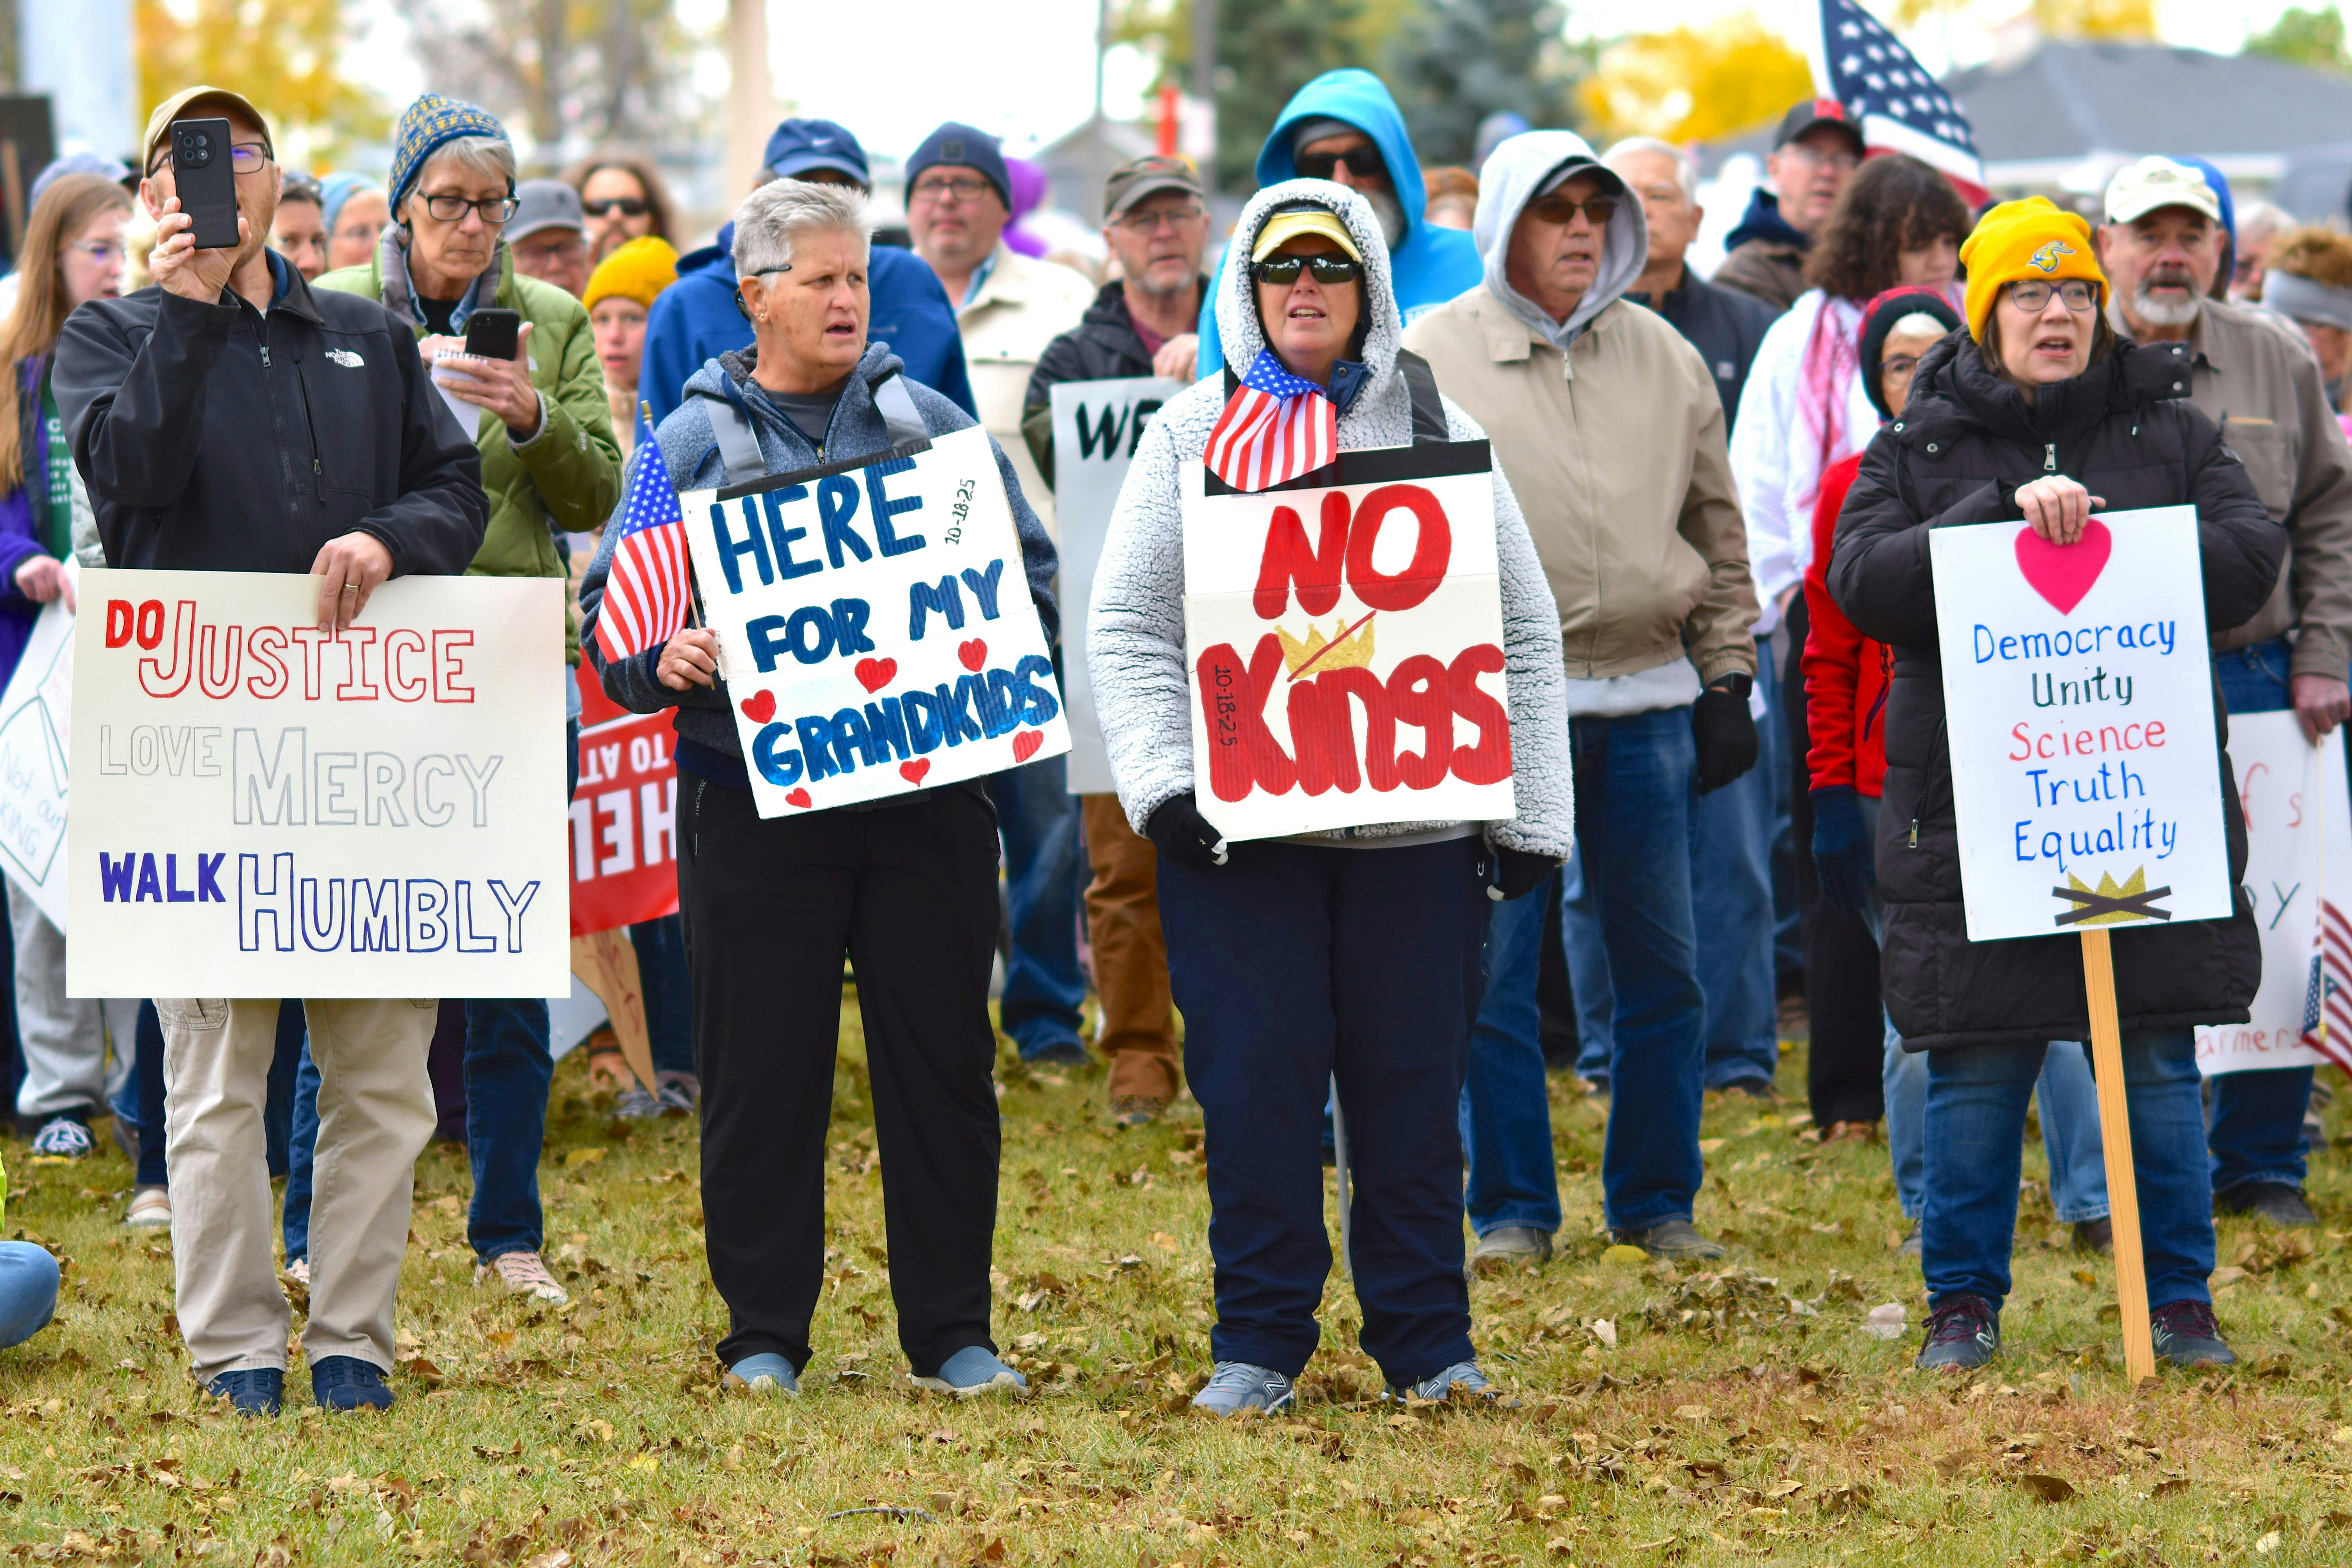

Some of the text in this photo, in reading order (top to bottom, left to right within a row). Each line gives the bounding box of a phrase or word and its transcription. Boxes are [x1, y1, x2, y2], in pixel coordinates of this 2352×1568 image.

[325, 352, 349, 362] NORTH
[334, 348, 347, 356] THE
[710, 456, 926, 594] HERE
[944, 478, 975, 545] 10-18-25
[1253, 483, 1452, 620] NO
[746, 559, 1004, 673] FOR MY
[1974, 619, 2176, 664] Democracy
[105, 599, 165, 650] DO
[138, 601, 475, 704] JUSTICE
[2032, 666, 2133, 707] Unity
[751, 654, 1059, 787] GRANDKIDS
[2009, 720, 2166, 761] Science
[100, 725, 503, 828] LOVE MERCY
[576, 733, 670, 786] TO AT
[2025, 760, 2146, 808] Truth
[2015, 807, 2177, 874] Equality
[100, 852, 540, 953] WALK HUMBLY
[2194, 1027, 2303, 1059] armers
